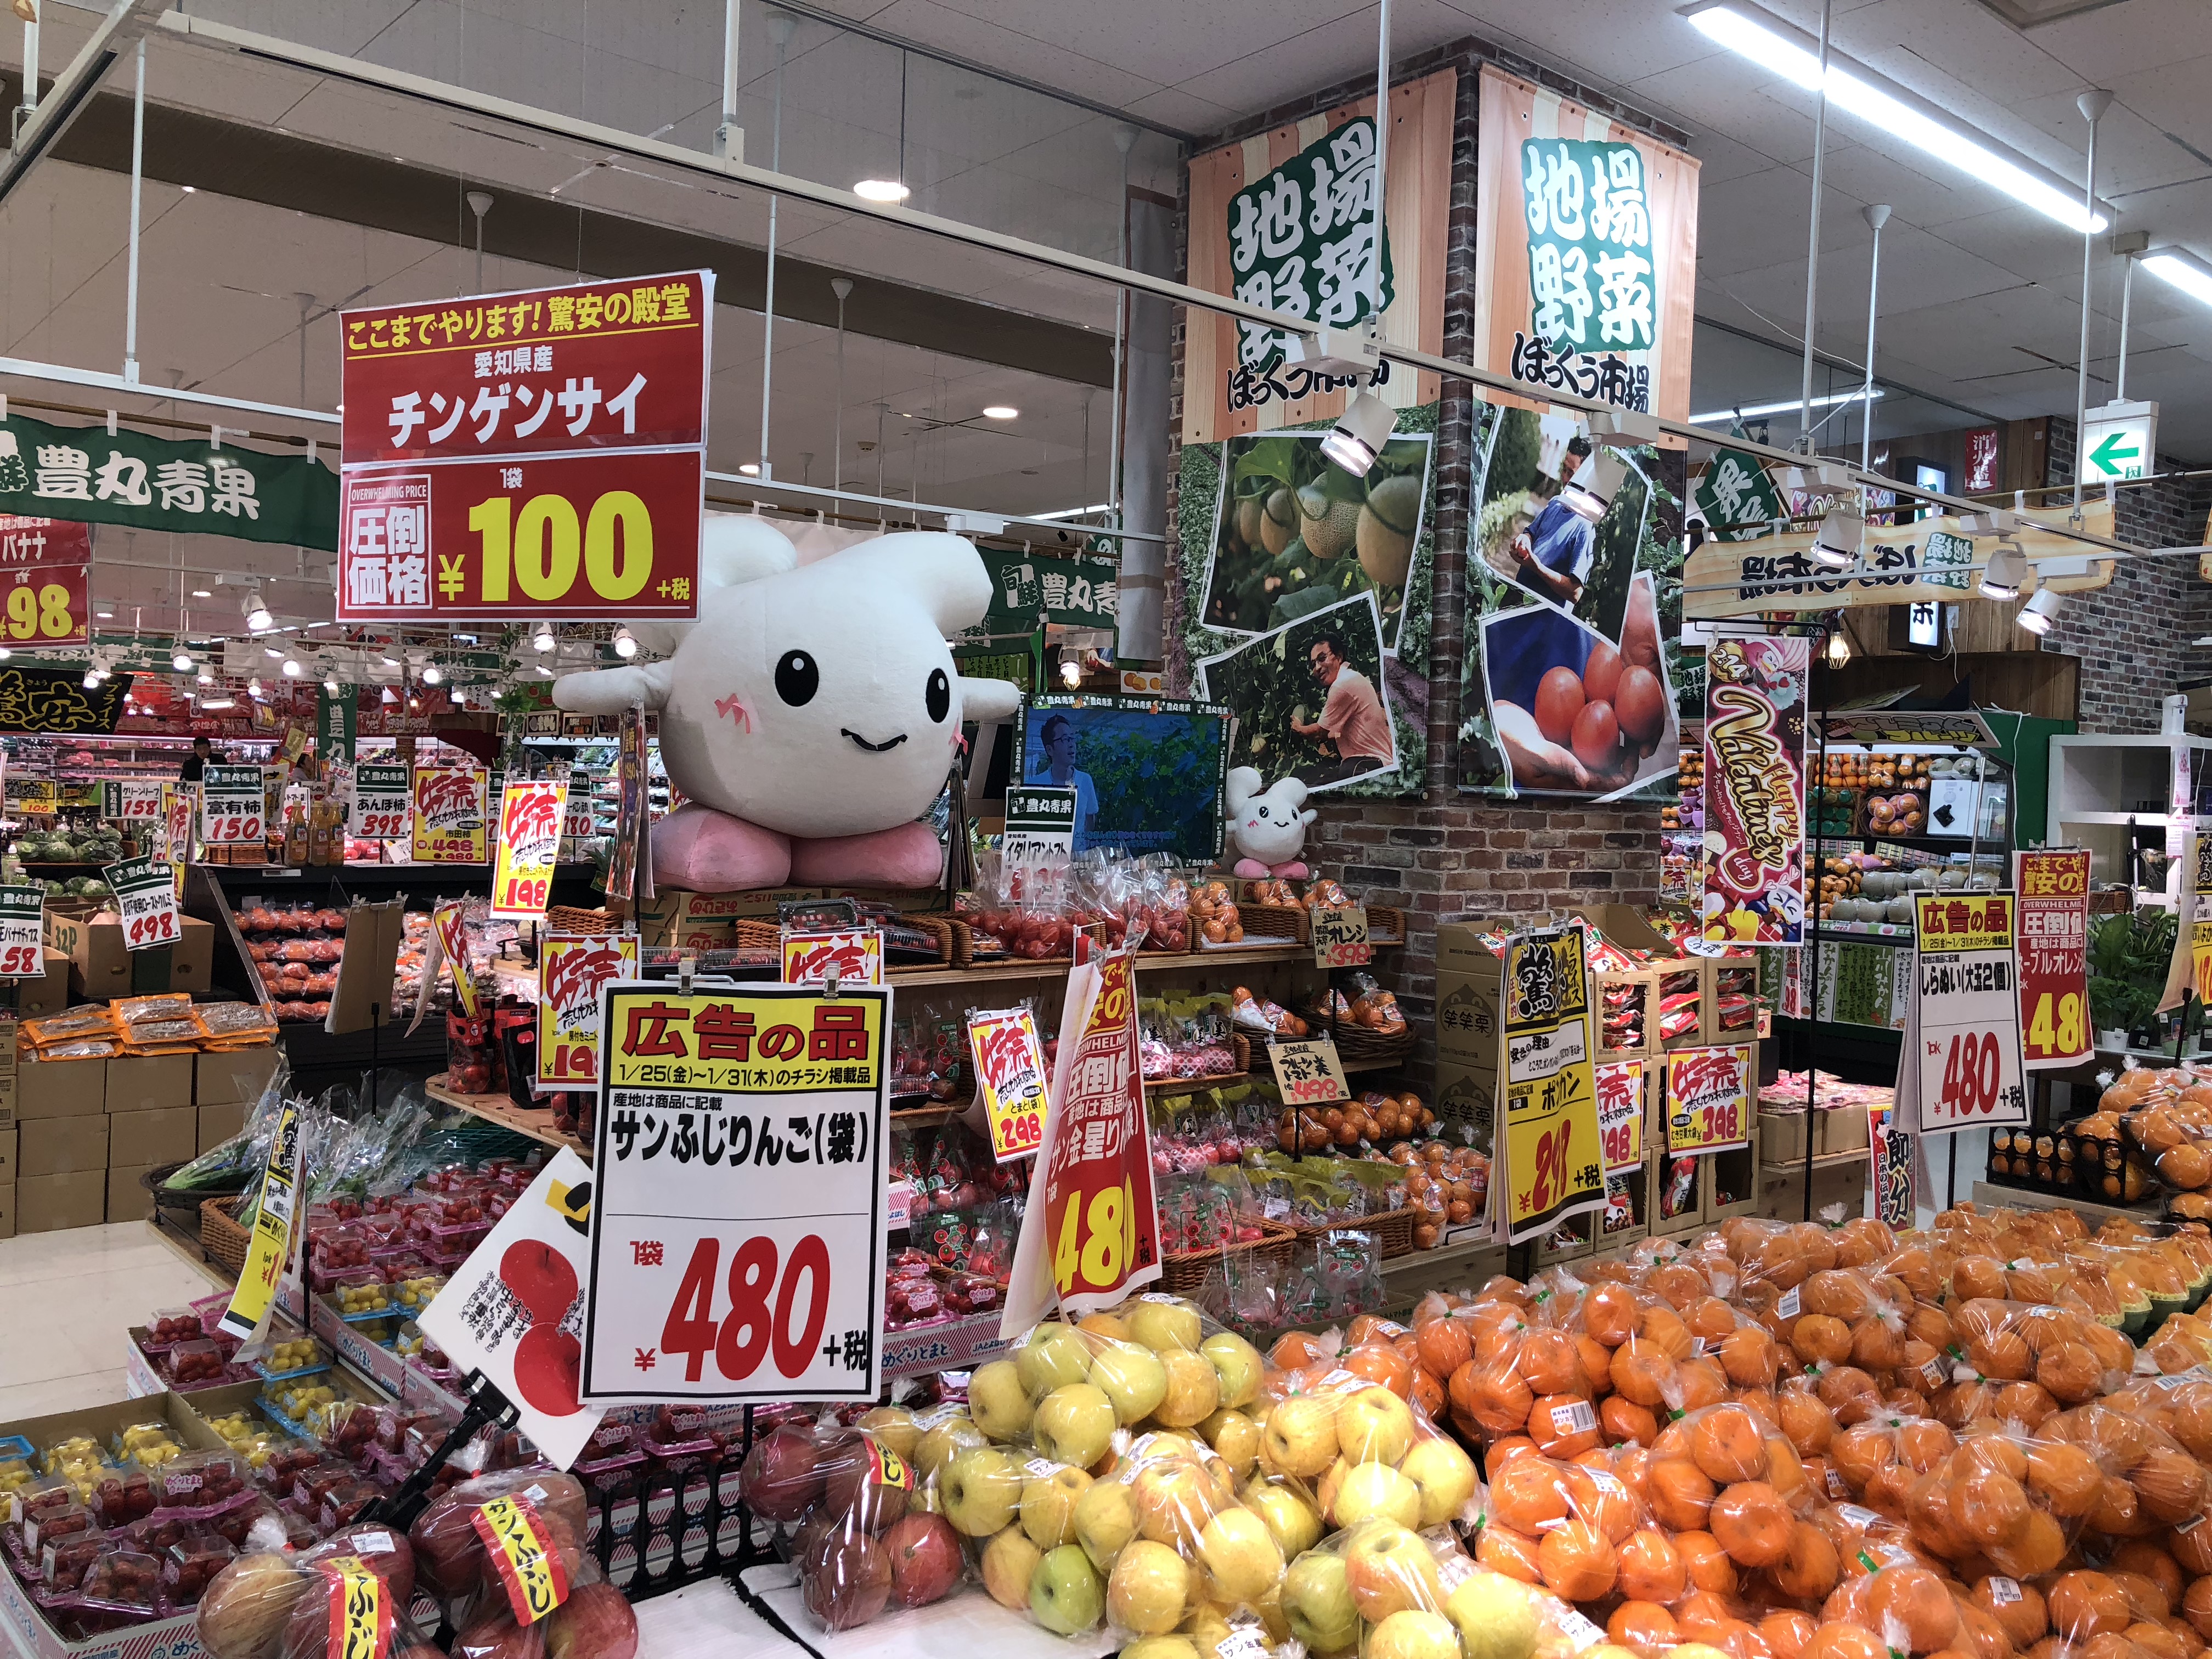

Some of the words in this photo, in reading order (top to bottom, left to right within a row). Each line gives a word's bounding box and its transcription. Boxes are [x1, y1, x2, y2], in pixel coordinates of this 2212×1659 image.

[1525, 143, 1650, 247] 地場
[1532, 243, 1652, 345] 野菜
[474, 345, 552, 378] 愛知県産
[388, 372, 647, 448] チンゲンサイ
[32, 444, 261, 520] 豊丸青果
[500, 468, 522, 489] 1袋
[352, 486, 404, 501] OVERWHELMING
[405, 485, 427, 499] PRICE
[349, 505, 425, 556] 圧倒
[2, 531, 47, 562] バナナ
[349, 555, 427, 605] 価格
[1711, 647, 1748, 679] 2.14
[122, 786, 160, 796] グリーンリーフ
[357, 798, 406, 812] あんぽ柿
[1762, 757, 1801, 847] Happy
[123, 800, 158, 816] 158
[207, 800, 261, 815] 富有柿
[1026, 798, 1072, 814] 豊丸青果
[212, 817, 260, 840] 150
[360, 814, 404, 836] 398
[445, 830, 471, 839] 市田柿
[1734, 856, 1754, 882] day
[129, 911, 173, 945] 498
[1922, 900, 2008, 934] 広告の品
[55, 924, 77, 955] 32P
[1327, 924, 1367, 945] オレンジ
[0, 946, 37, 973] 58
[1567, 933, 1582, 1005] プライス
[1921, 961, 2011, 996] しらぬい(大玉2個)
[621, 1000, 870, 1062] 広告の品
[1443, 1008, 1490, 1035] 笑笑栗
[1510, 1035, 1550, 1063] 安さの理由
[1283, 1068, 1312, 1082] トマト
[613, 1092, 723, 1112] 産地は商品に記載
[1011, 1097, 1041, 1114] とまと(袋)
[611, 1109, 868, 1168] サンふじりんご(袋)
[1574, 1164, 1601, 1189] +税
[629, 1239, 664, 1267] 1袋
[823, 1329, 868, 1373] +税
[881, 1342, 949, 1367] めぐりとまと
[487, 1499, 551, 1613] サンふじ
